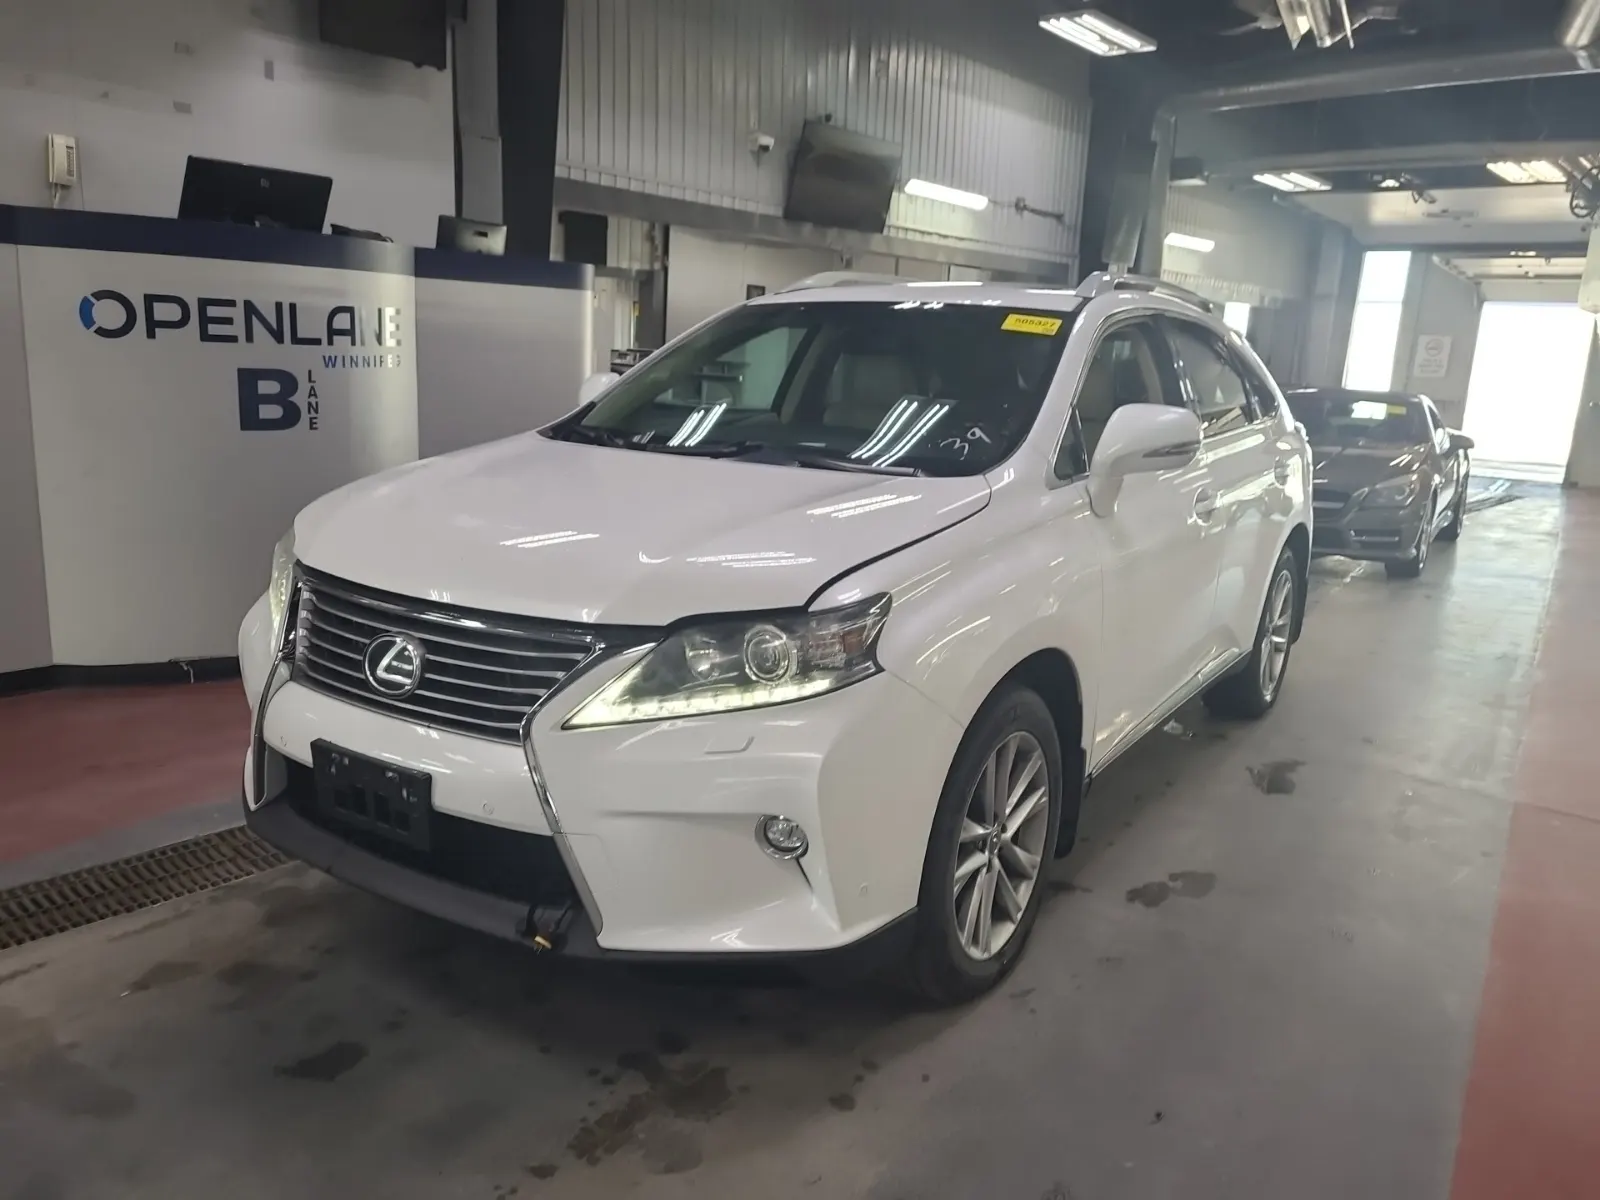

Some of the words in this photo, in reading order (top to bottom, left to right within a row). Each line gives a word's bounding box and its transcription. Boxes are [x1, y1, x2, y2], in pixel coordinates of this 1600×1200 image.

[79, 289, 402, 347] OPENLANE
[237, 367, 302, 431] B
[307, 369, 319, 430] LANE
